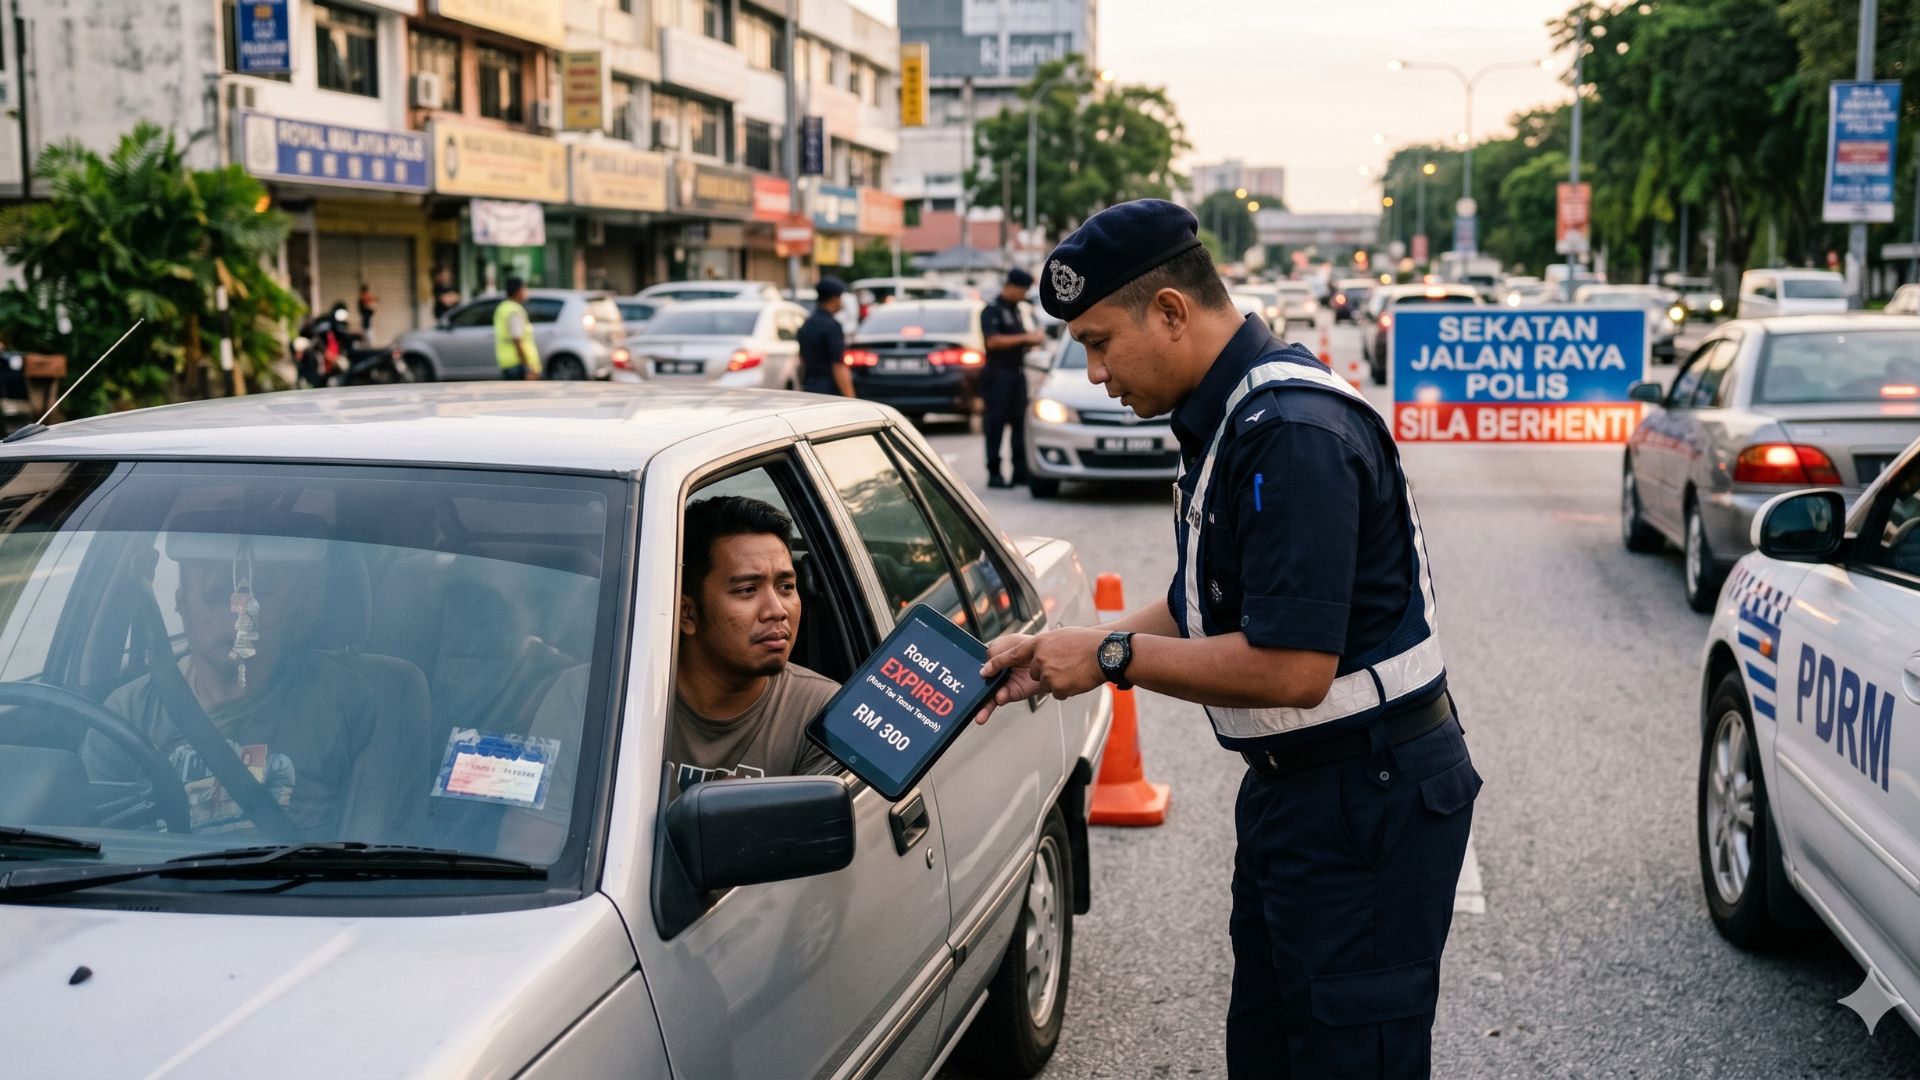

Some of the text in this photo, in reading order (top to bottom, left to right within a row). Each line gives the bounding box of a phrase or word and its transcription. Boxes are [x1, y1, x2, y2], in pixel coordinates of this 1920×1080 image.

[278, 120, 326, 150] ROYAL
[387, 135, 424, 162] POLIS
[1438, 315, 1598, 342] SEKATAN
[1411, 343, 1626, 371] JALAN RAYA
[1466, 372, 1569, 400] POLIS
[1399, 407, 1635, 441] SILA BERHENTI
[880, 657, 954, 716] EXPIRED
[903, 643, 965, 694] Road Tax:
[852, 703, 911, 751] RM 300
[1796, 641, 1895, 793] PDRM
